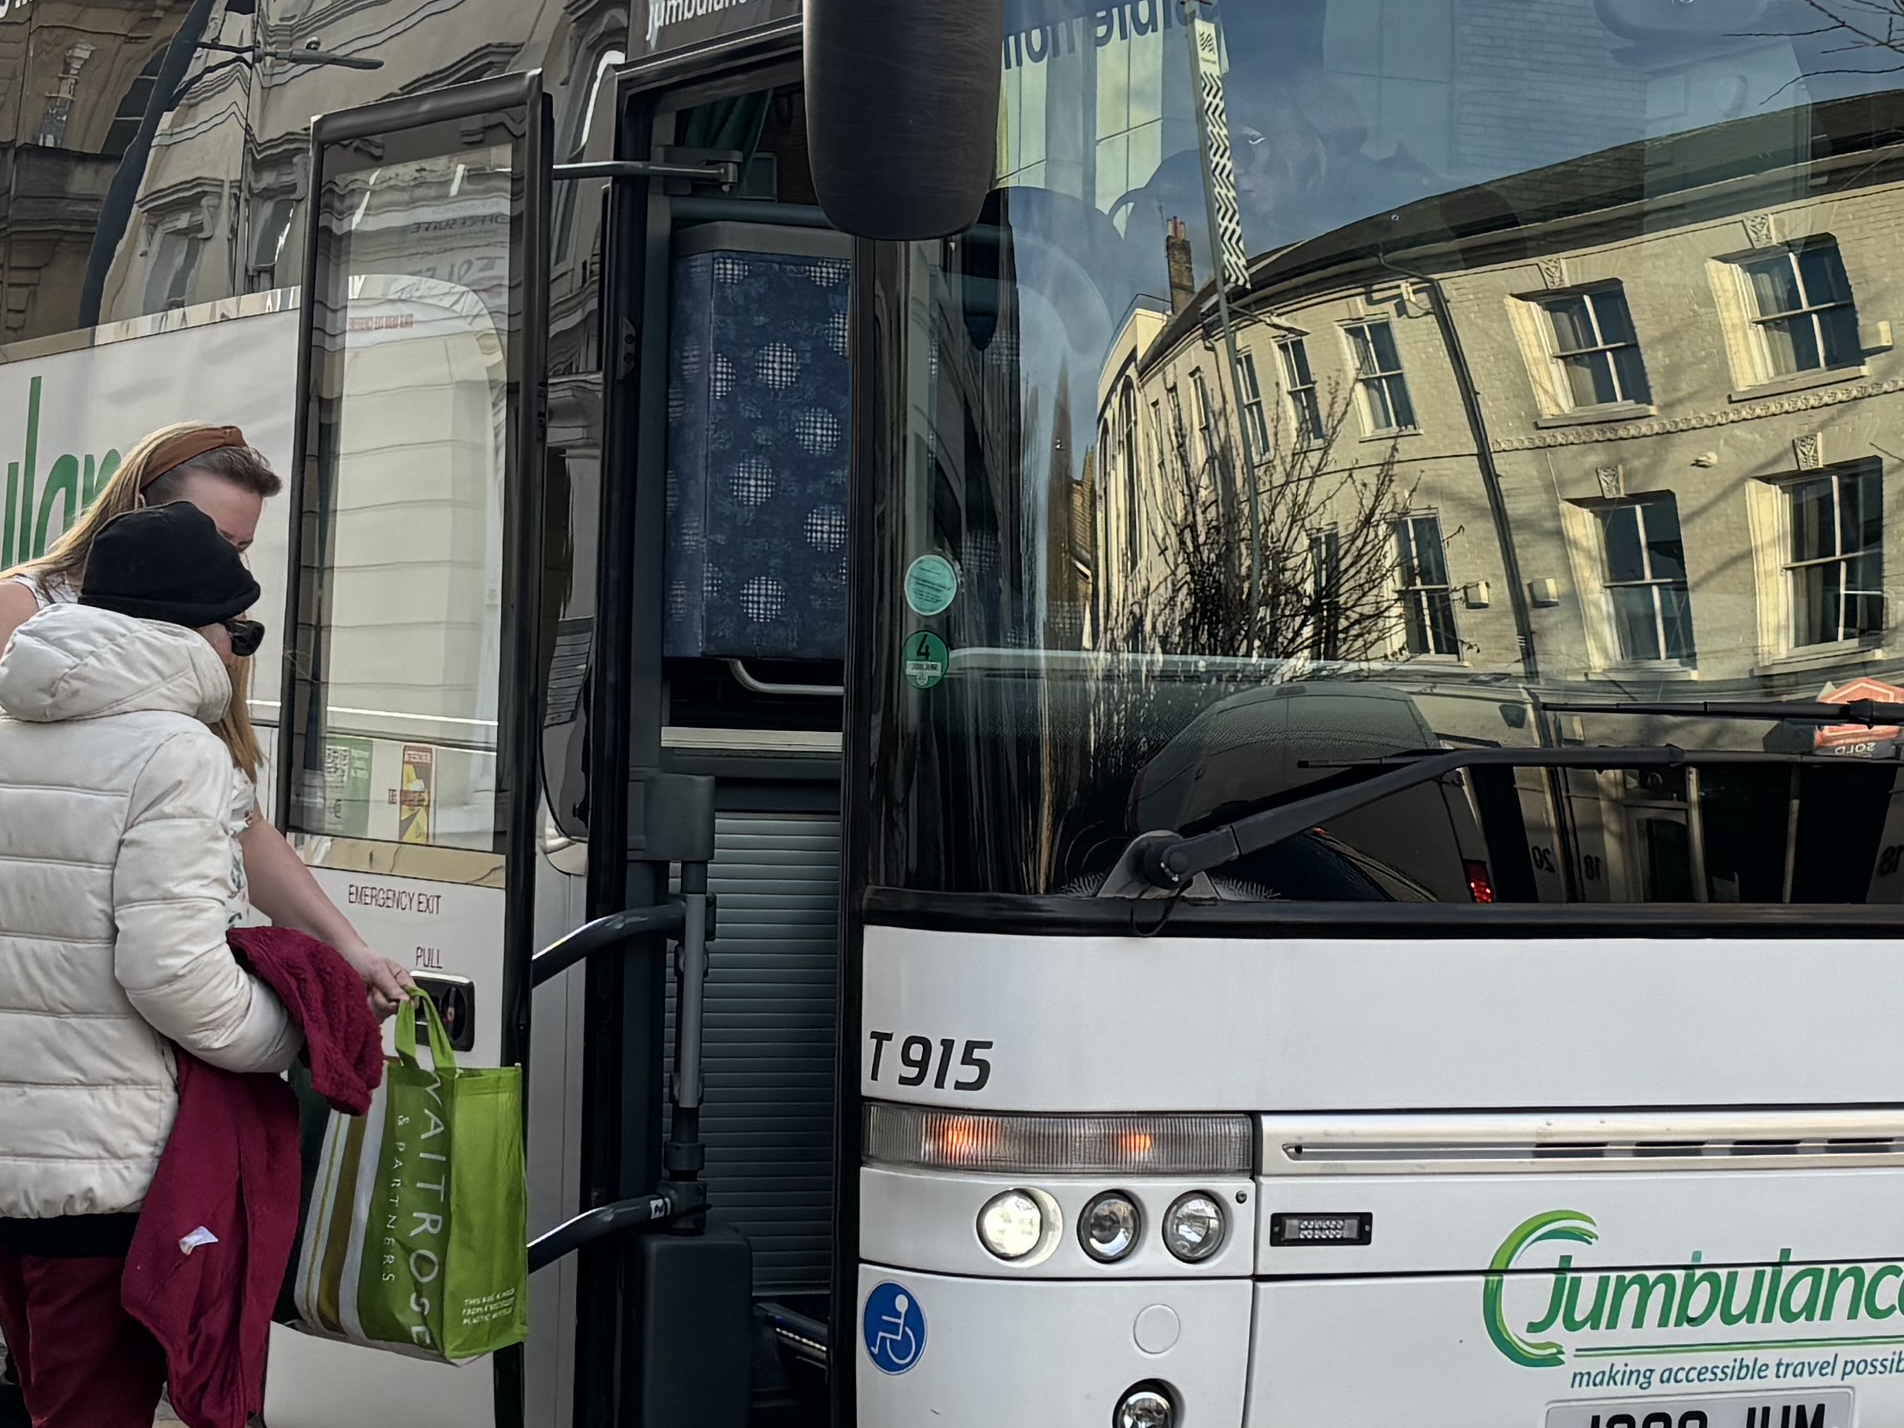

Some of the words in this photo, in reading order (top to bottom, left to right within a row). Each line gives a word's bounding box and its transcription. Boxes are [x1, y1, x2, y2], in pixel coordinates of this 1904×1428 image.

[916, 634, 931, 661] 4
[348, 883, 414, 911] EMERGENCY
[417, 893, 442, 915] EXIT
[415, 946, 443, 969] PULL
[397, 1114, 410, 1126] &
[382, 1141, 407, 1282] PARTNERS
[1570, 1362, 1654, 1390] making
[1659, 1356, 1770, 1385] accessible
[1775, 1353, 1838, 1380] travel
